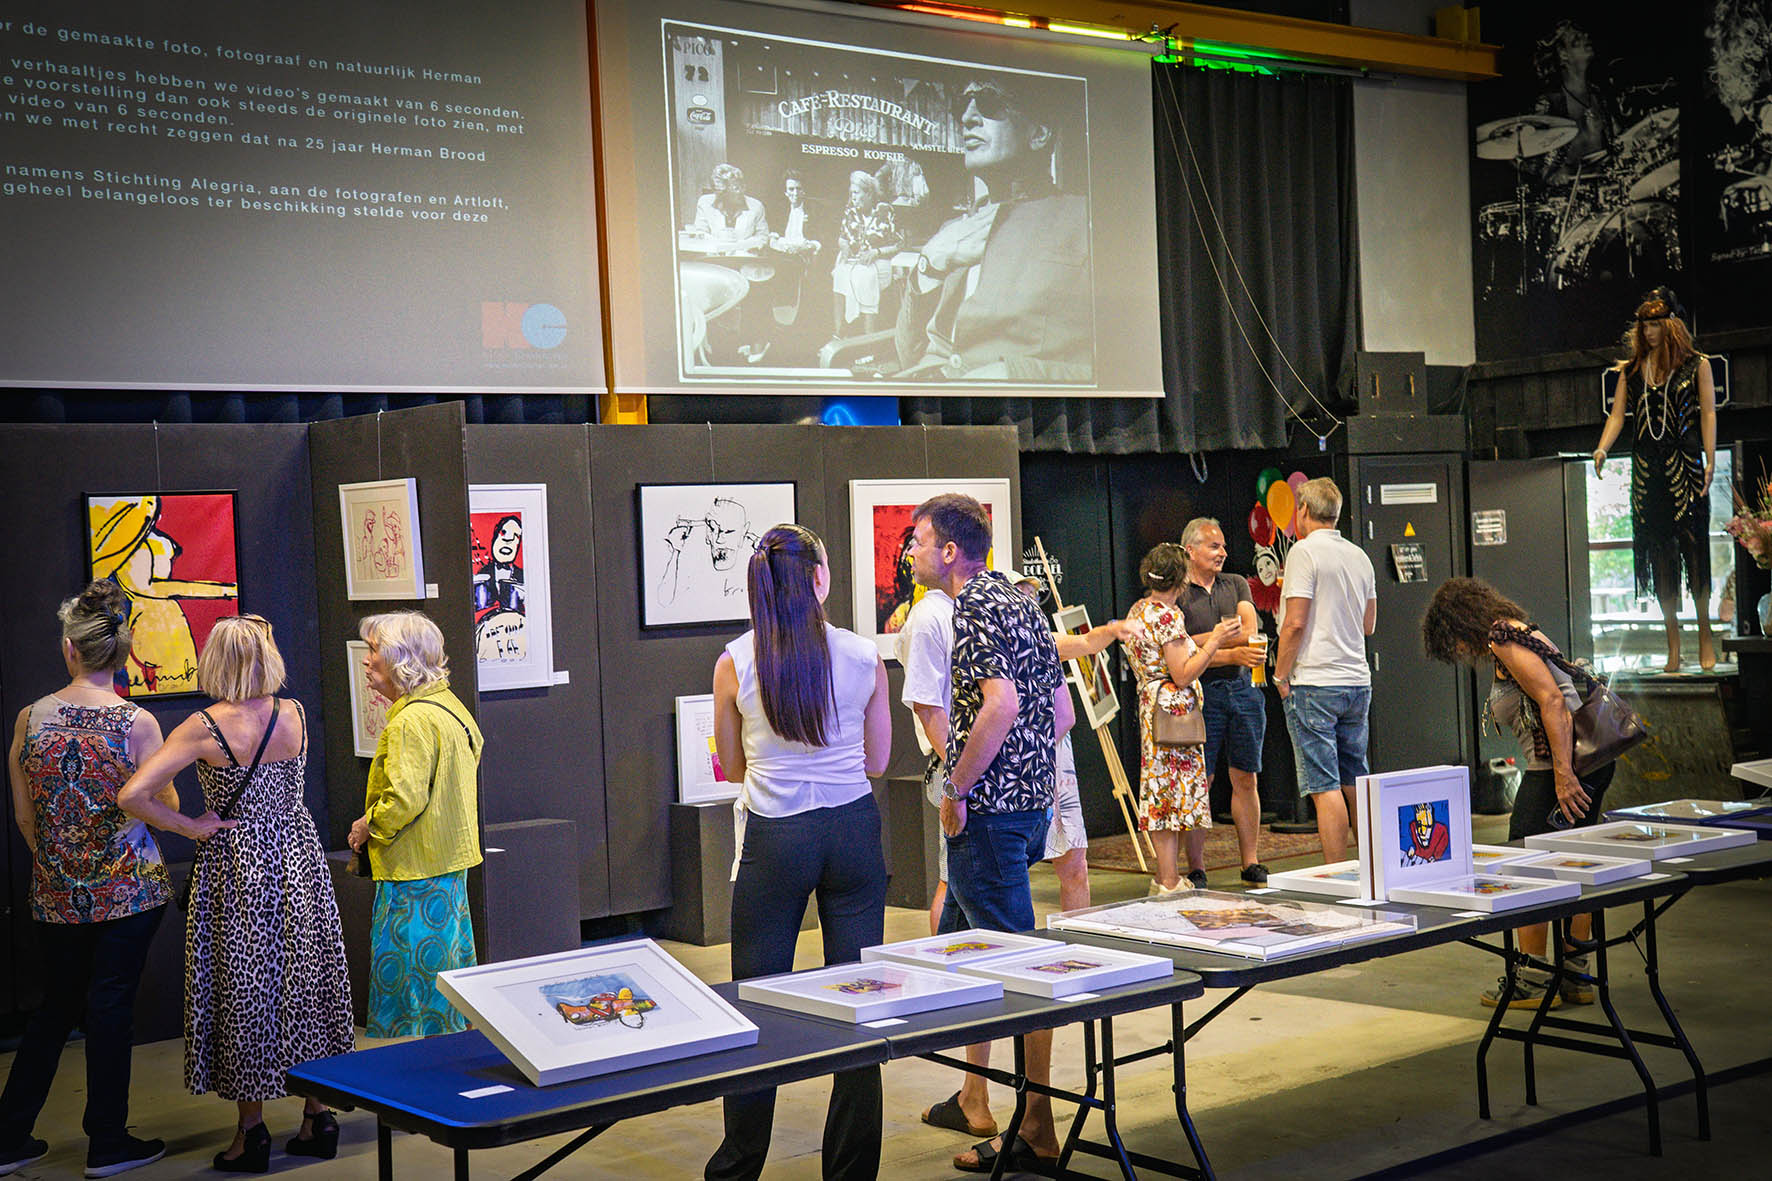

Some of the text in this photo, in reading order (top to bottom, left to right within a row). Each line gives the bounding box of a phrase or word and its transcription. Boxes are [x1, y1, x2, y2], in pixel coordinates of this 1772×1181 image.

[23, 22, 47, 37] de
[57, 28, 154, 49] gemaakte
[217, 46, 301, 66] fotograaf
[308, 58, 328, 69] en
[336, 61, 416, 79] natuurlijk
[423, 69, 482, 85] Herman
[8, 92, 235, 126] video van 6 seconden.
[11, 57, 525, 120] verhaaltjes hebben we video's gemaakt van 6 seconden.
[24, 77, 147, 103] voorstelling
[155, 90, 189, 105] dan
[198, 97, 231, 109] ook
[239, 99, 298, 115] steeds
[306, 105, 326, 118] de
[334, 108, 407, 125] originele
[414, 114, 447, 128] foto
[496, 123, 524, 135] met
[26, 113, 52, 127] we
[63, 116, 98, 131] met
[108, 121, 158, 136] recht
[167, 126, 233, 143] zeggen
[241, 132, 269, 146] dat
[278, 138, 297, 149] na
[305, 137, 324, 150] 25
[332, 140, 364, 153] jaar
[371, 142, 432, 158] Herman
[440, 148, 486, 162] Brood
[801, 144, 859, 158] ESPRESSO
[3, 181, 488, 223] geheel belangeloos ter beschikking stelde voor deze
[6, 164, 84, 181] namens
[94, 170, 182, 191] Stichting
[191, 177, 261, 196] Alegria,
[270, 186, 300, 197] aan
[308, 186, 328, 198] de
[335, 188, 422, 205] fotografen
[429, 194, 447, 205] en
